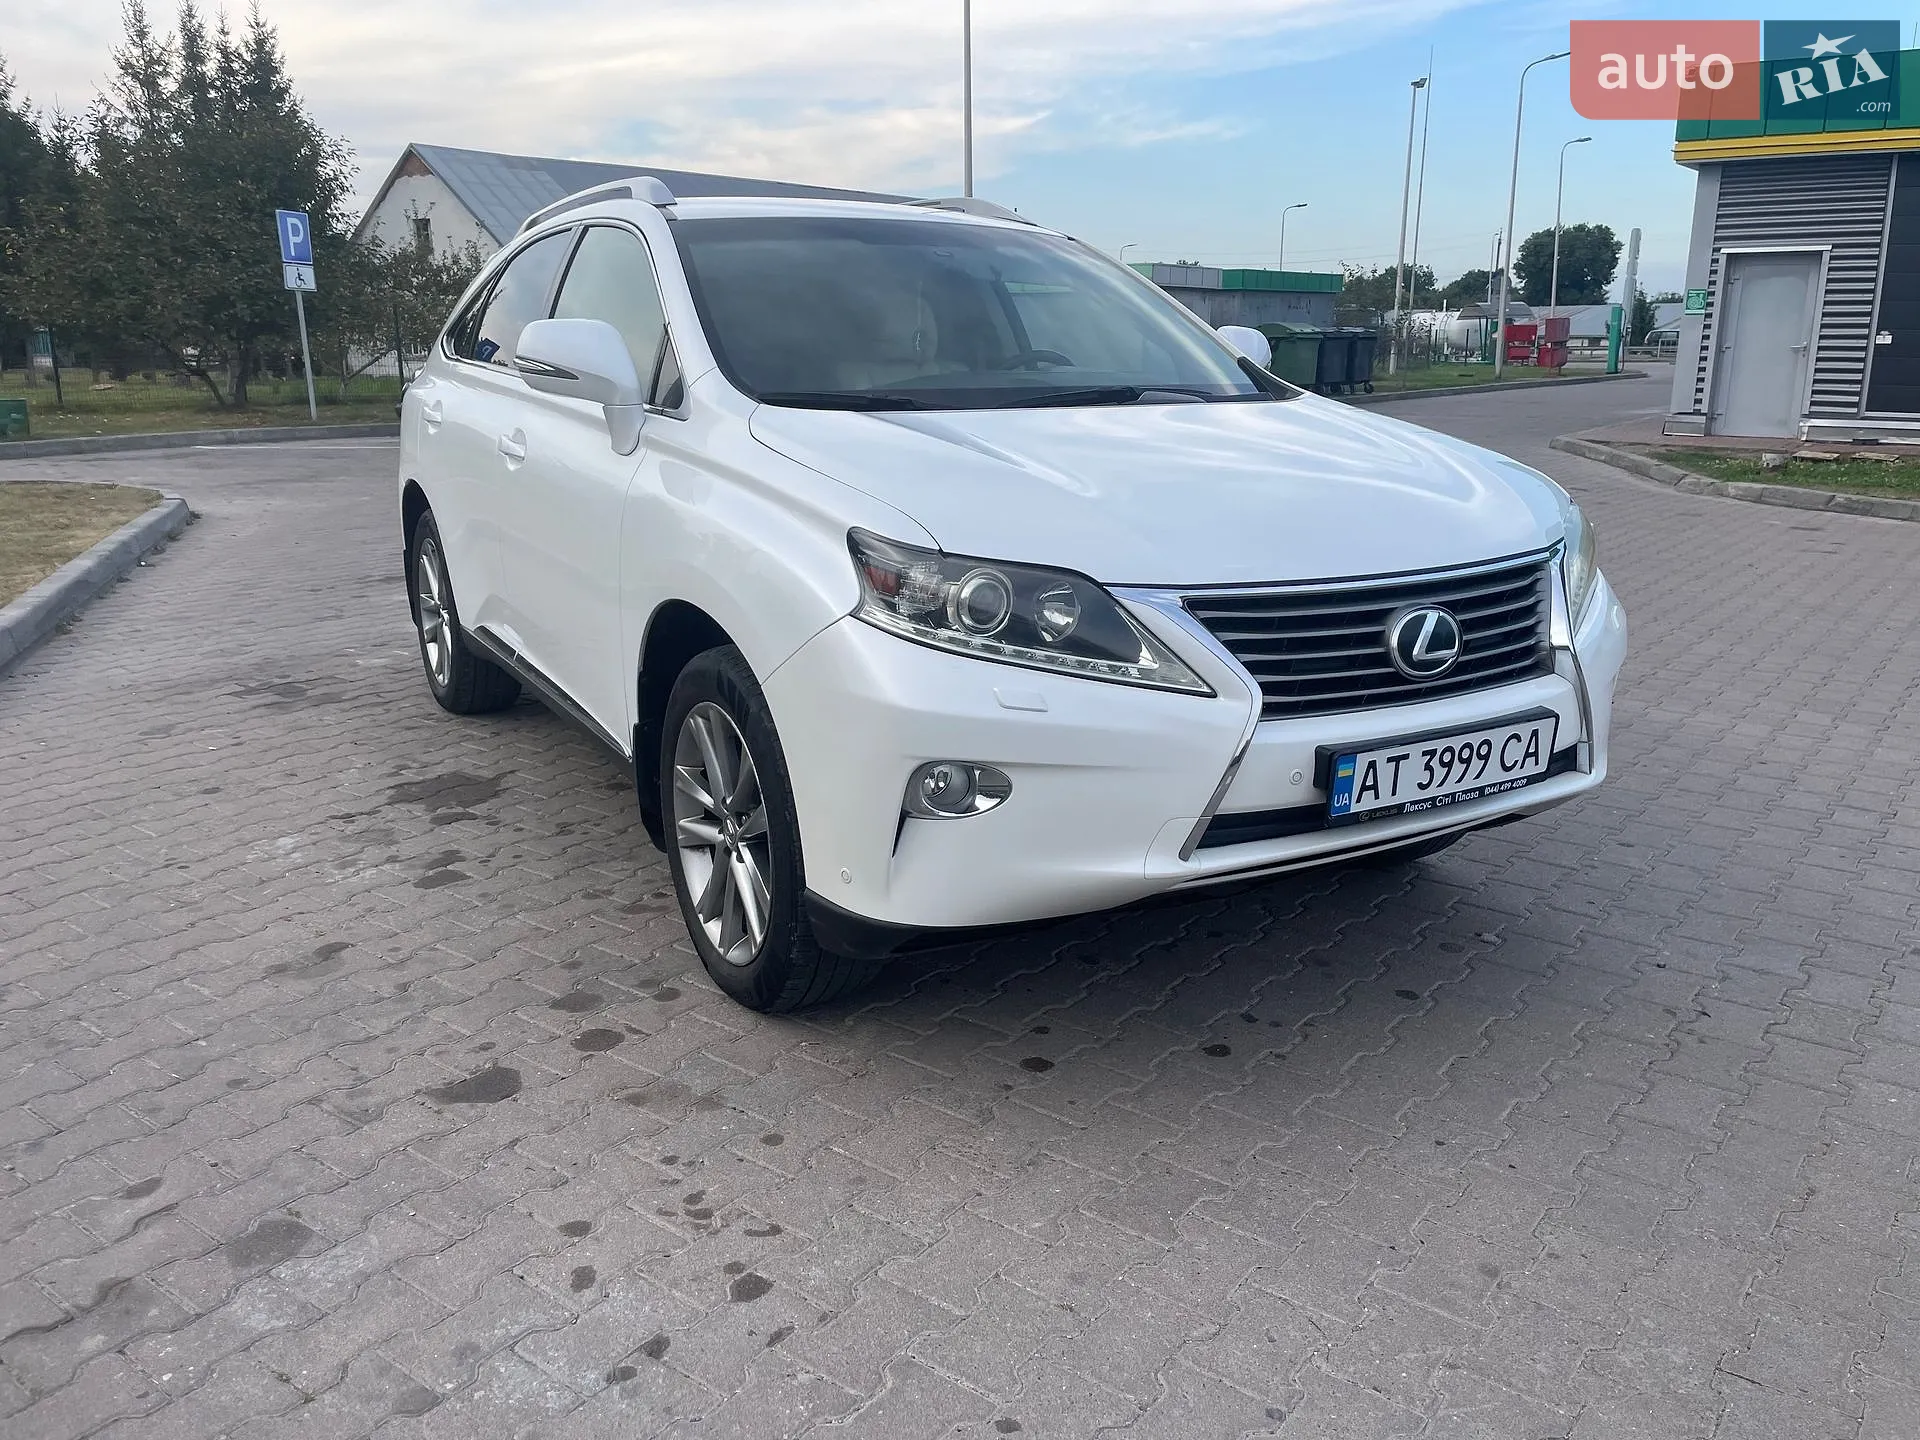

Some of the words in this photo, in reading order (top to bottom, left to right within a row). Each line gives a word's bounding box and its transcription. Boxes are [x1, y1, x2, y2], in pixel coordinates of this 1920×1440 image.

[286, 217, 304, 257] P
[1355, 752, 1410, 804] AT
[1416, 738, 1493, 791] 3999
[1499, 728, 1541, 773] CA
[1333, 792, 1350, 807] UA
